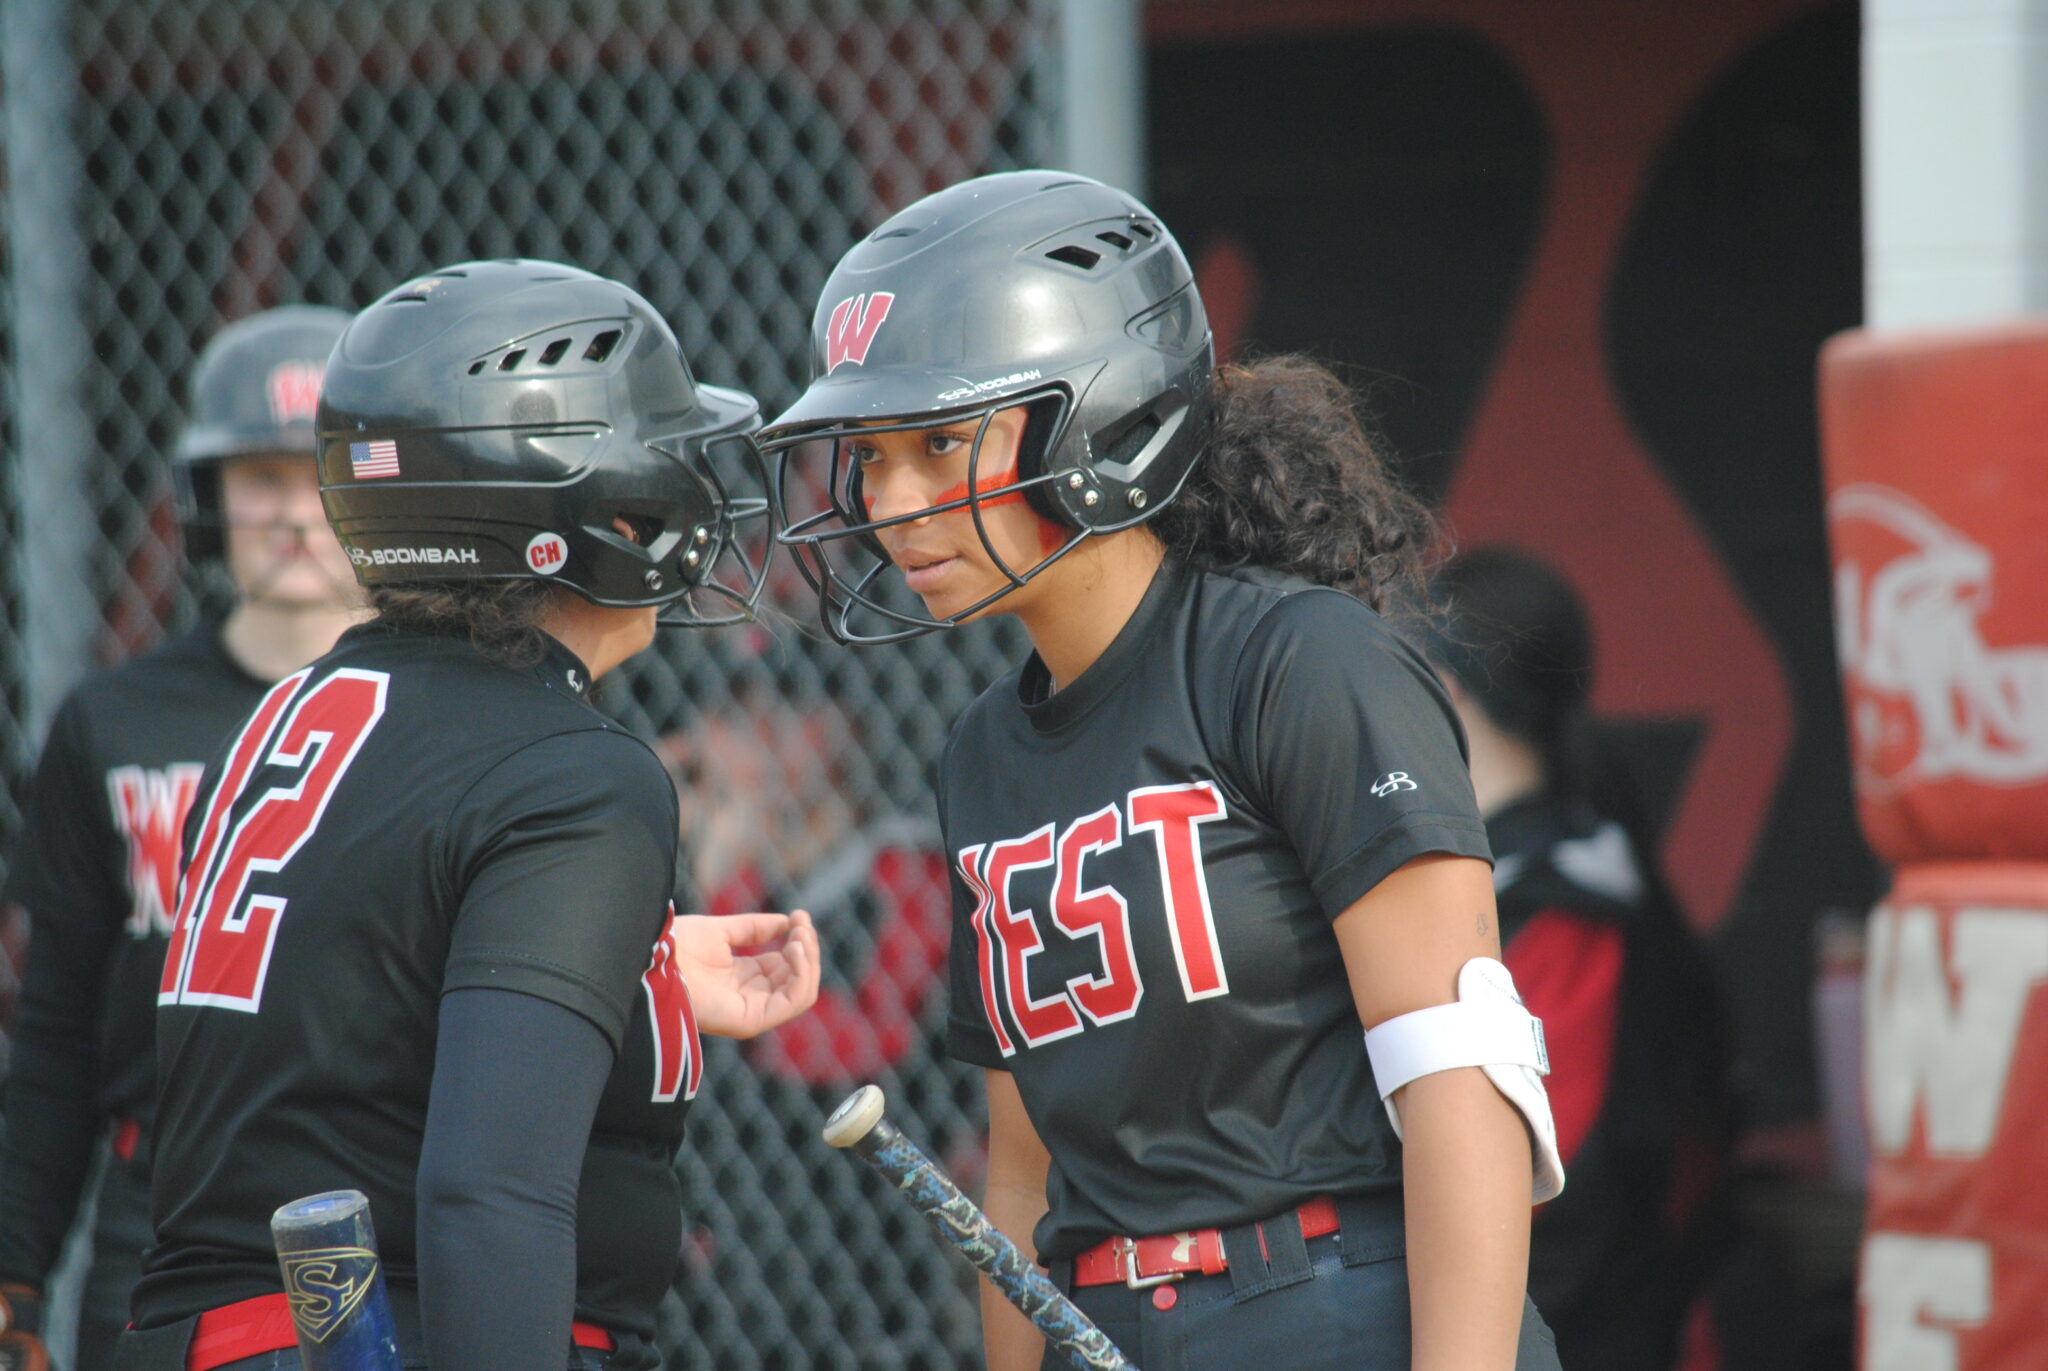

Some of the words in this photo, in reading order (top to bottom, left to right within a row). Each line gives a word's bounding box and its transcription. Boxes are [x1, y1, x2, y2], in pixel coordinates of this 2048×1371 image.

[826, 291, 896, 376] W
[371, 548, 479, 564] BOOMBAH
[530, 541, 561, 568] CH
[157, 666, 391, 1014] 12
